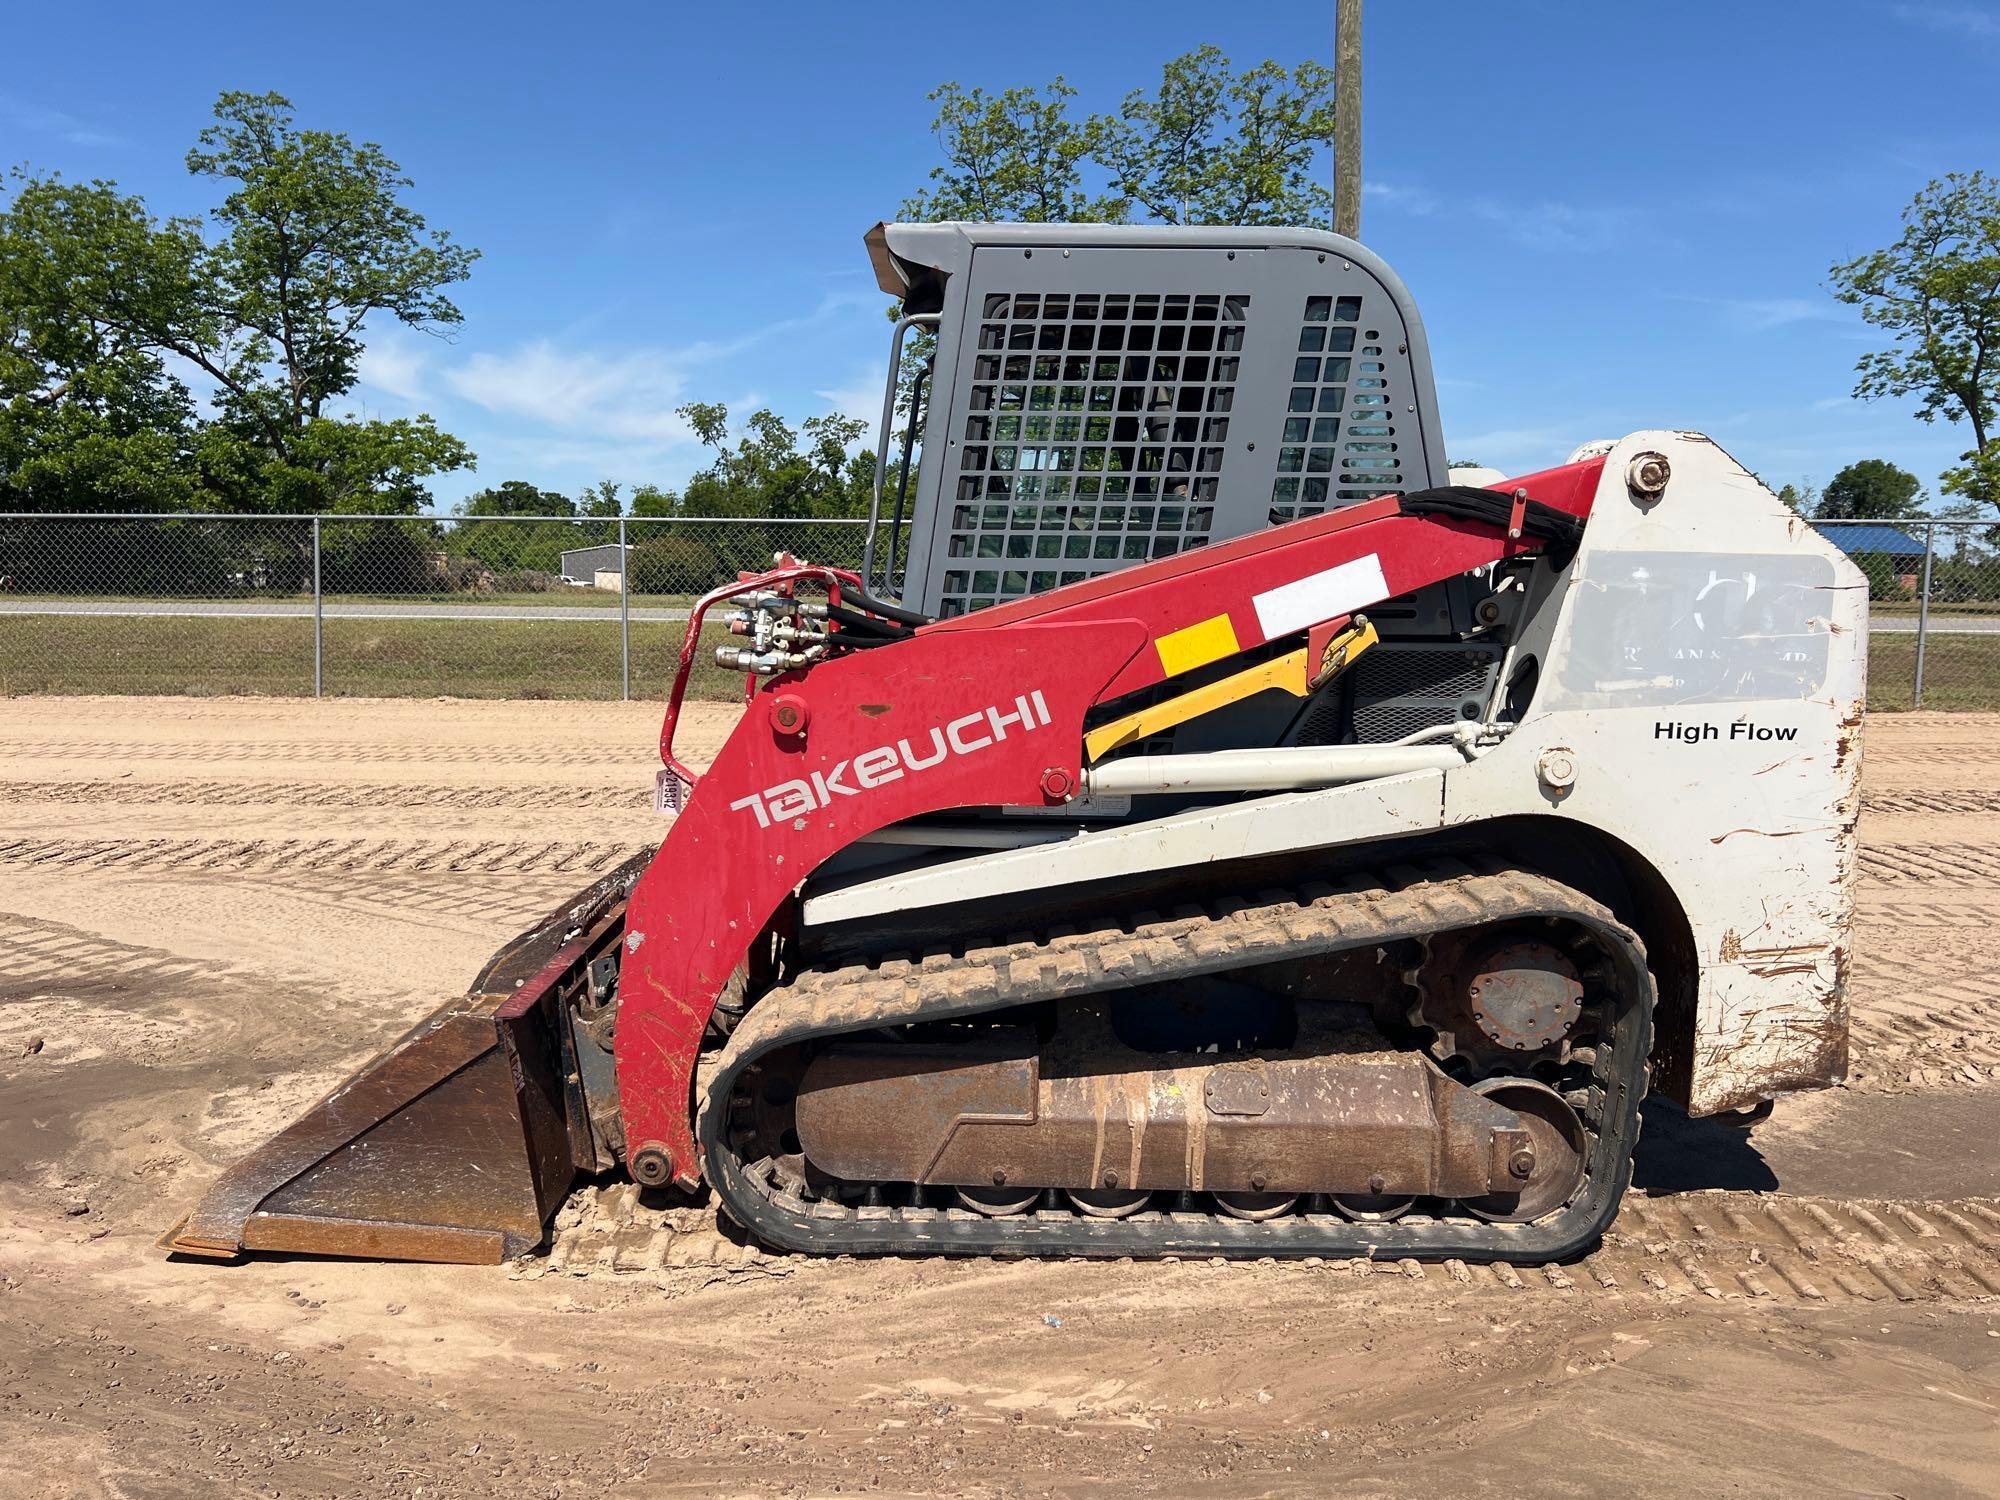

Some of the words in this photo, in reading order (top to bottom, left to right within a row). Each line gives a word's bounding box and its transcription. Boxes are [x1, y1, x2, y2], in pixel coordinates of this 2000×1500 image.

[1654, 722, 1719, 744] High
[1730, 722, 1798, 741] Flow
[663, 777, 679, 809] 219342
